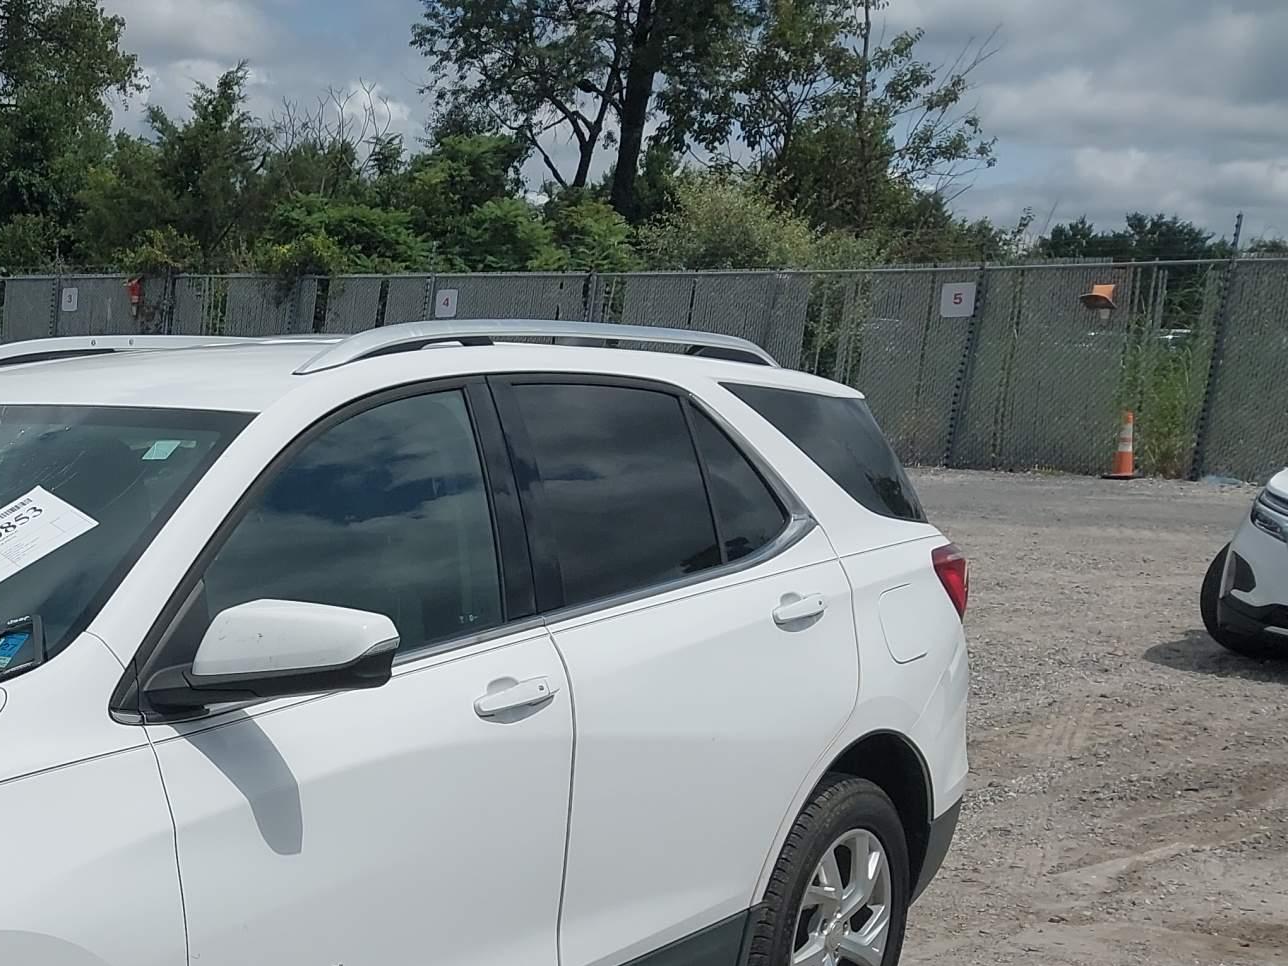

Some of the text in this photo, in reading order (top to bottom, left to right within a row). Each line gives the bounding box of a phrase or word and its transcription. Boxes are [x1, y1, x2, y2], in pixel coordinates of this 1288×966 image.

[66, 294, 73, 304] 3
[442, 297, 450, 308] 4
[952, 292, 964, 305] 5
